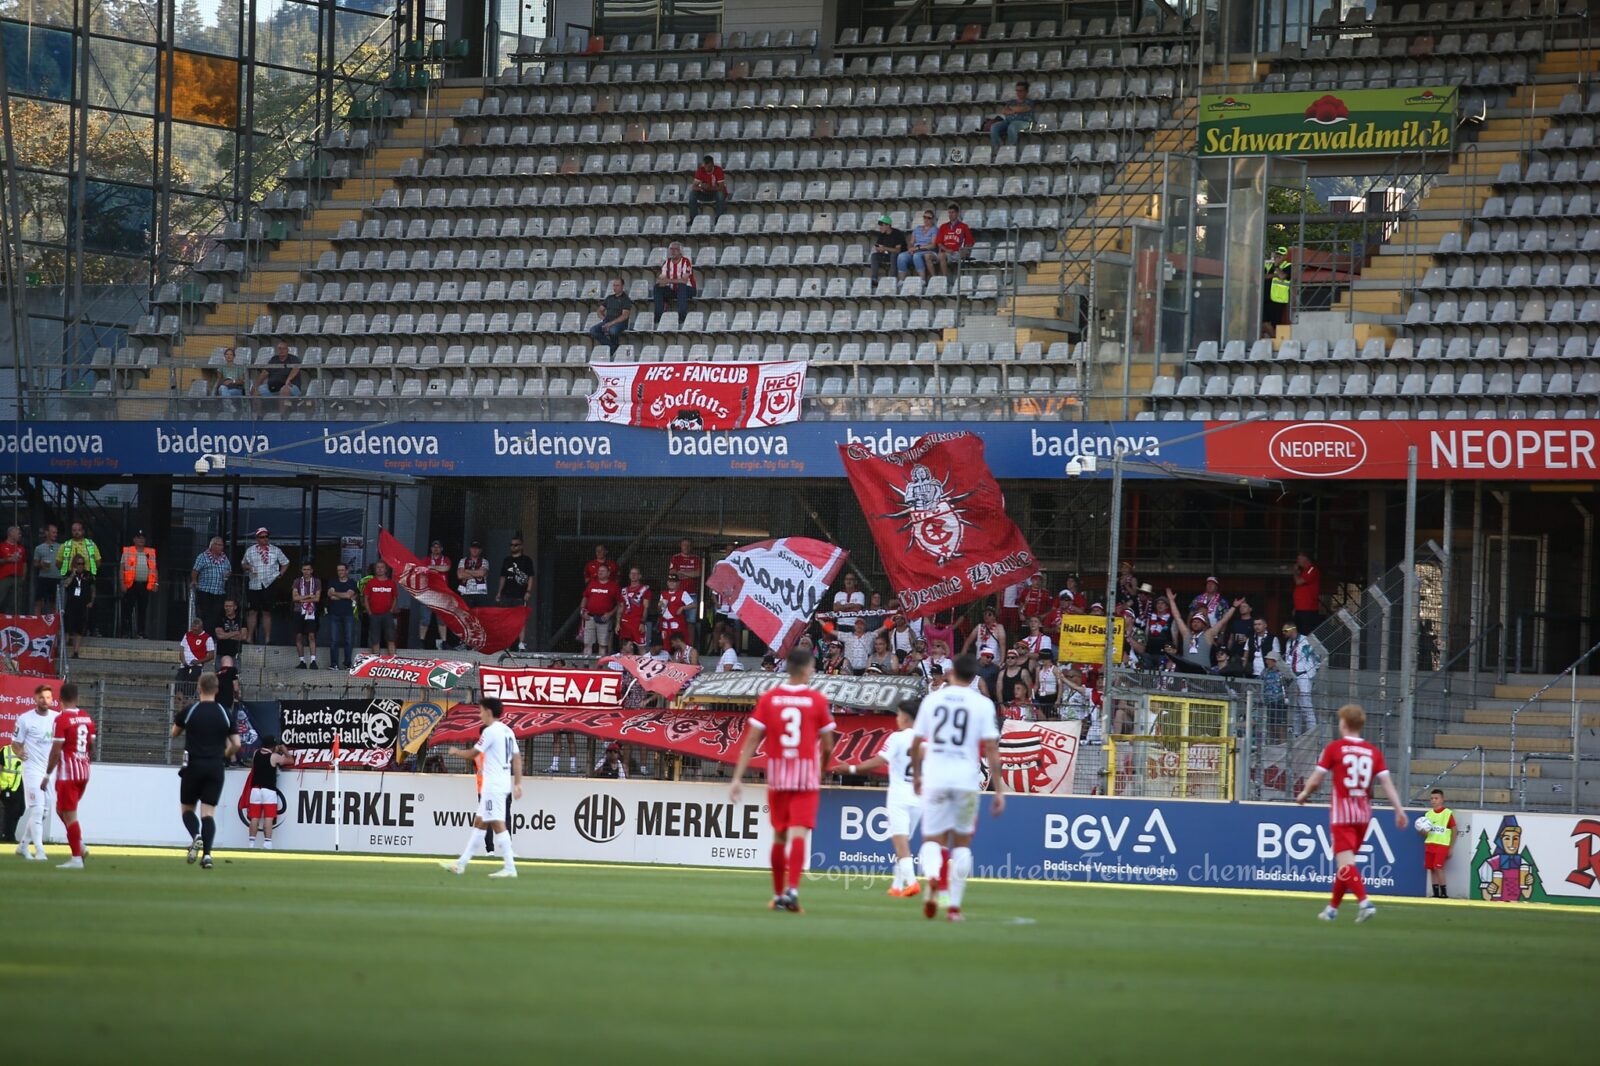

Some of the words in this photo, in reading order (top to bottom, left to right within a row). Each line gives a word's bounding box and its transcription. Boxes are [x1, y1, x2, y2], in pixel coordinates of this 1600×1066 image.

[1204, 119, 1449, 153] Schwarzwaldmilch
[645, 366, 674, 382] HFC
[682, 365, 748, 384] FANCLUB
[765, 374, 799, 391] HFC
[156, 427, 269, 454] badenova
[324, 428, 439, 455] badenova
[494, 428, 612, 455] badenova
[667, 430, 788, 455] badenova
[847, 428, 922, 455] baden
[1031, 428, 1160, 456] badenova
[1280, 441, 1356, 458] NEOPERL
[1430, 430, 1597, 469] NEOPER
[1063, 624, 1086, 633] Halle
[368, 665, 421, 682] SÜDHARZ
[482, 674, 619, 704] SURREALE
[379, 699, 401, 716] HFC
[77, 723, 89, 752] 8
[282, 727, 331, 745] Chemie
[780, 707, 802, 748] 3
[933, 705, 969, 747] 29
[1342, 753, 1374, 789] 39
[297, 790, 415, 827] MERKLE
[636, 801, 760, 840] MERKLE
[840, 805, 893, 842] BG
[1044, 813, 1131, 852] BGV
[369, 834, 414, 847] BEWEGT
[711, 847, 758, 860] BEWEGT
[839, 851, 886, 864] Badische
[1044, 859, 1092, 873] Badische
[1094, 862, 1176, 878] Versicherungen
[1256, 869, 1306, 883] Badische
[1308, 872, 1395, 889] Versiungen
